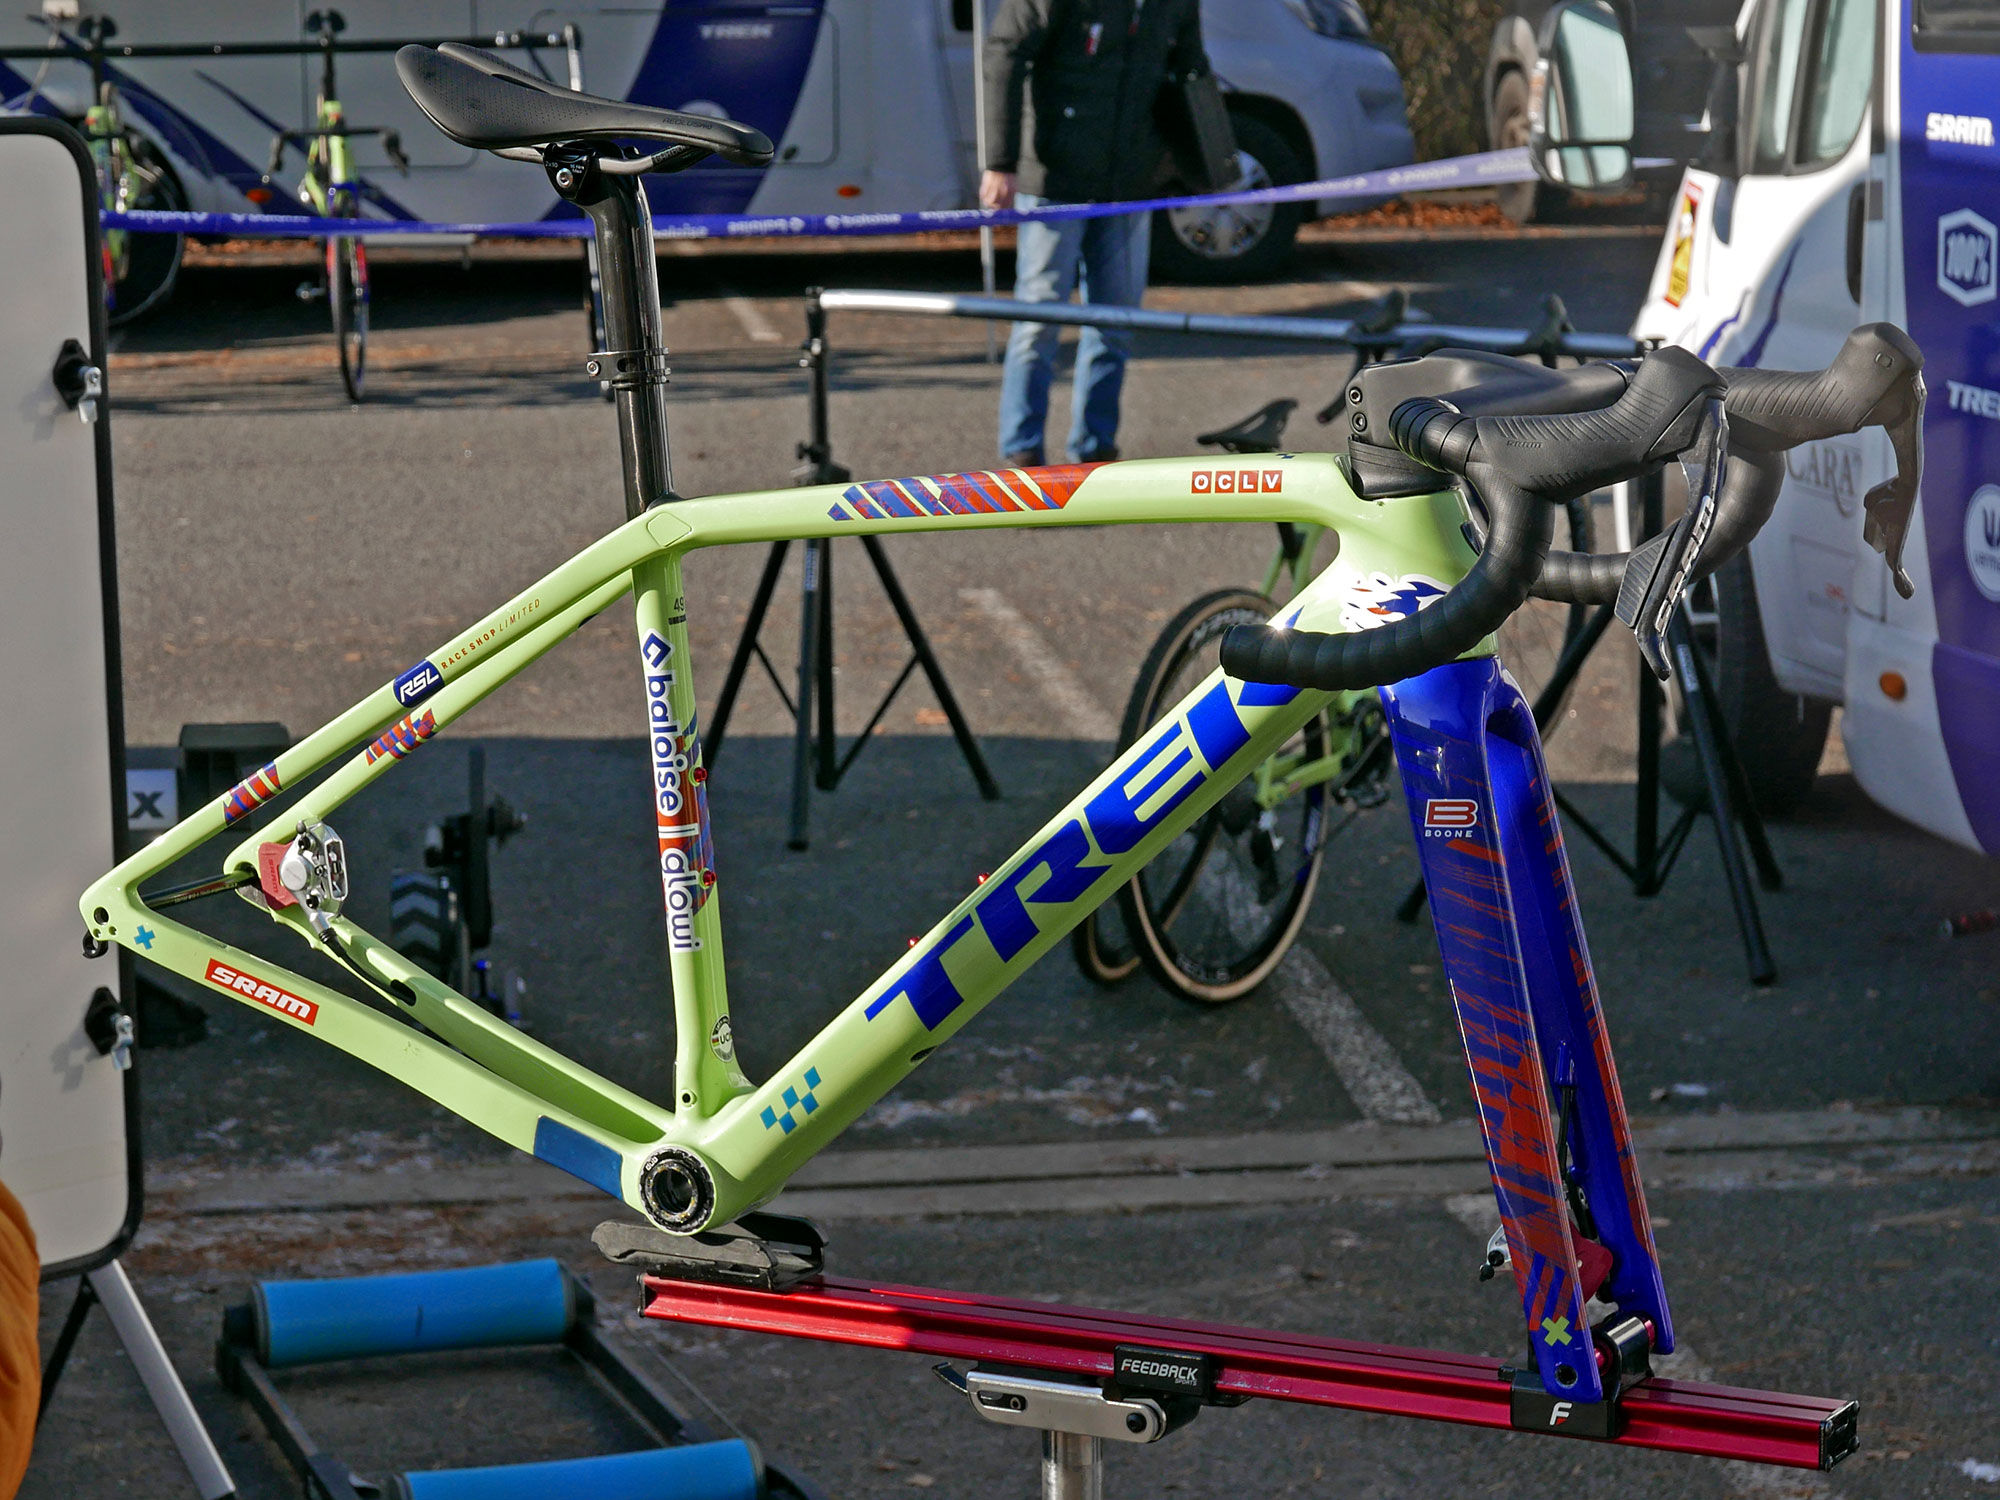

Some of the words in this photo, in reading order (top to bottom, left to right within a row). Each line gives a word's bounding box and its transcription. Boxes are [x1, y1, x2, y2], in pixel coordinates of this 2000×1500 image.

[1926, 112, 1993, 147] SRAM
[1946, 379, 2000, 421] TRE
[1194, 473, 1281, 492] OCLV
[440, 648, 468, 670] RACE
[469, 628, 496, 651] SHOP
[499, 598, 541, 632] LIMITED
[400, 667, 440, 703] RSL
[647, 673, 684, 812] baloise
[1424, 798, 1478, 828] B
[1425, 829, 1473, 838] BOONE
[661, 852, 701, 949] glowi
[211, 966, 311, 1019] SRAM
[1121, 1358, 1199, 1381] FEEDBACK
[1174, 1378, 1198, 1386] SPORTS
